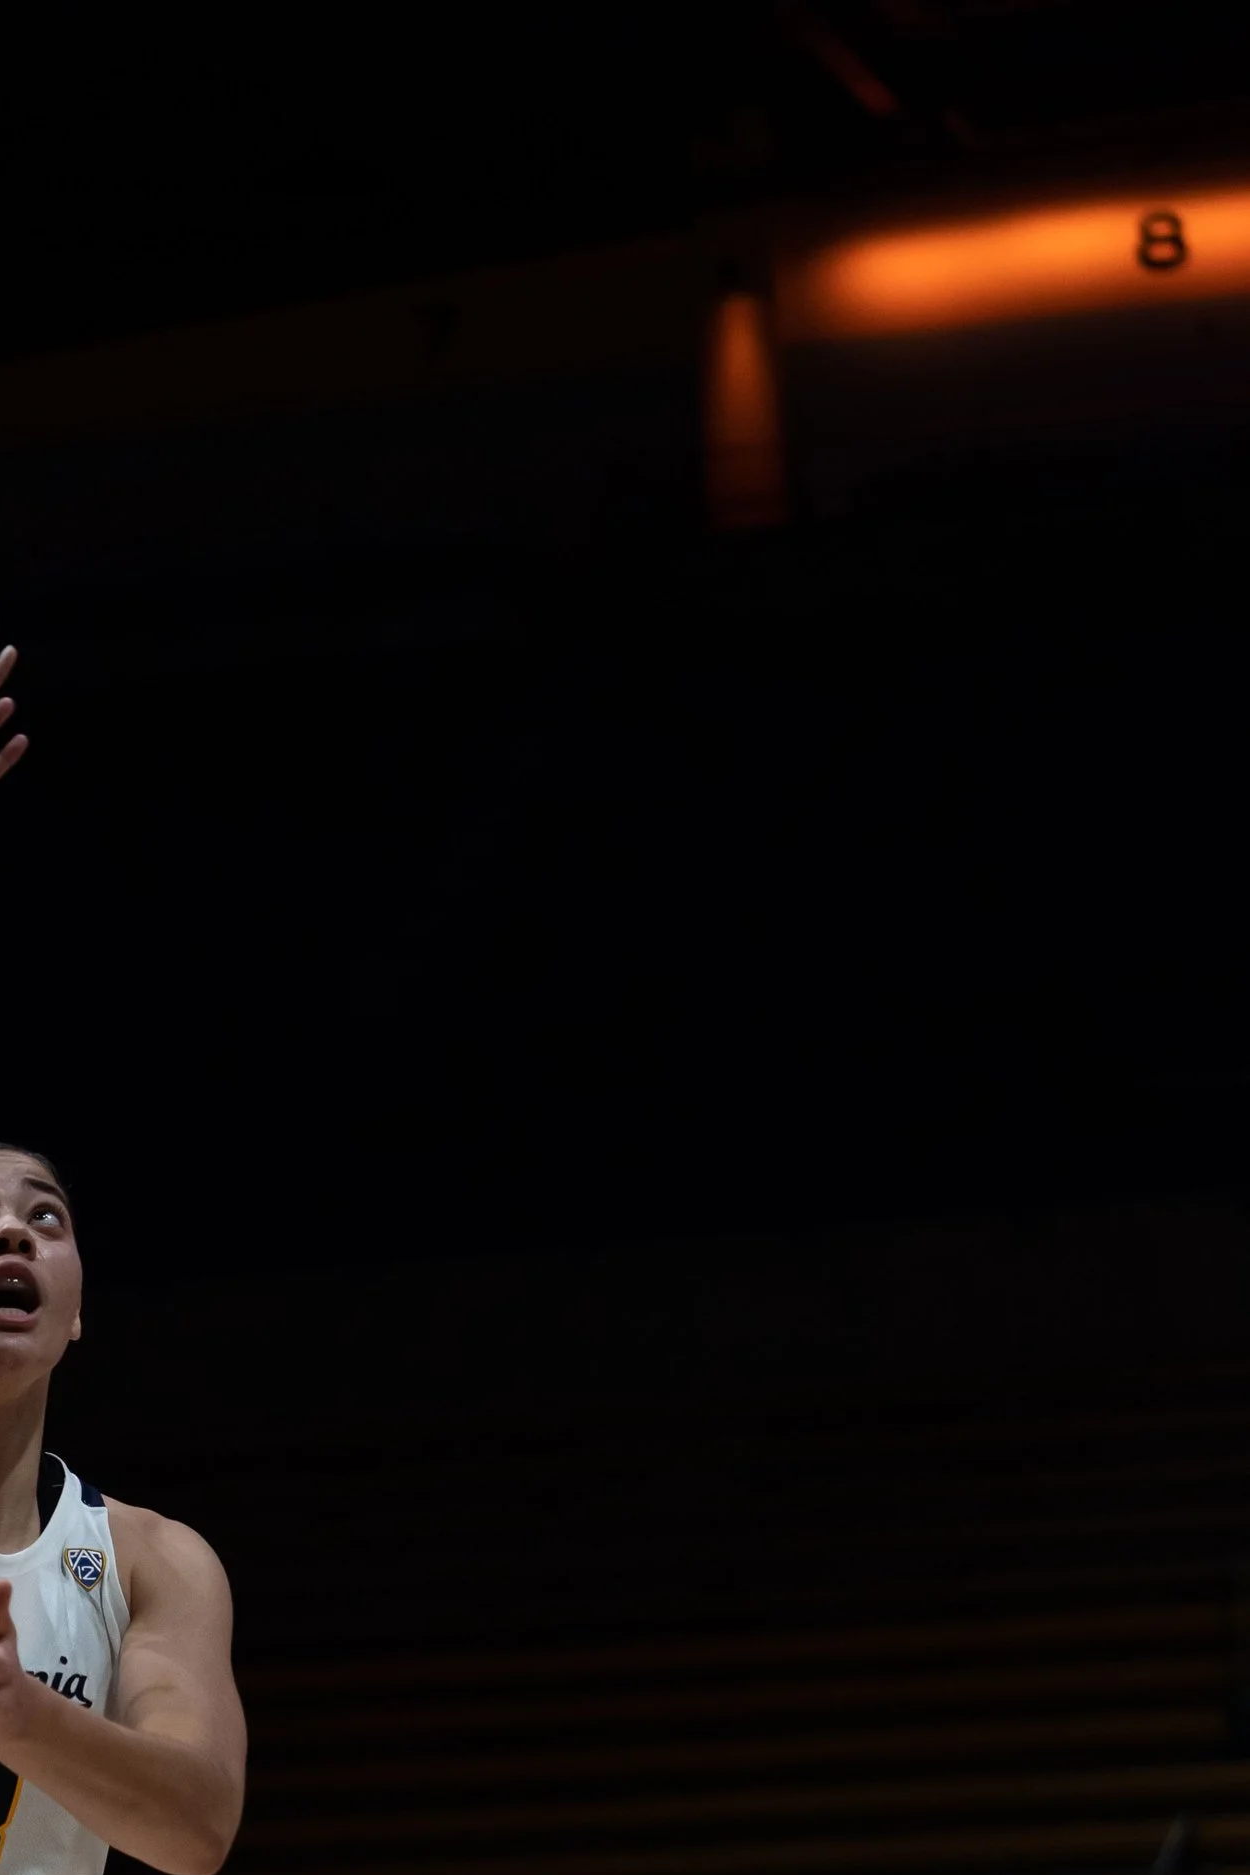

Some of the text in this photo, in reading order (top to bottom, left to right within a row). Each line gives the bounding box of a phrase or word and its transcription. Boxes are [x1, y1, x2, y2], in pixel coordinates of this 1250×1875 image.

[1137, 211, 1187, 270] 8
[67, 1549, 103, 1572] PAC
[77, 1565, 97, 1580] 12
